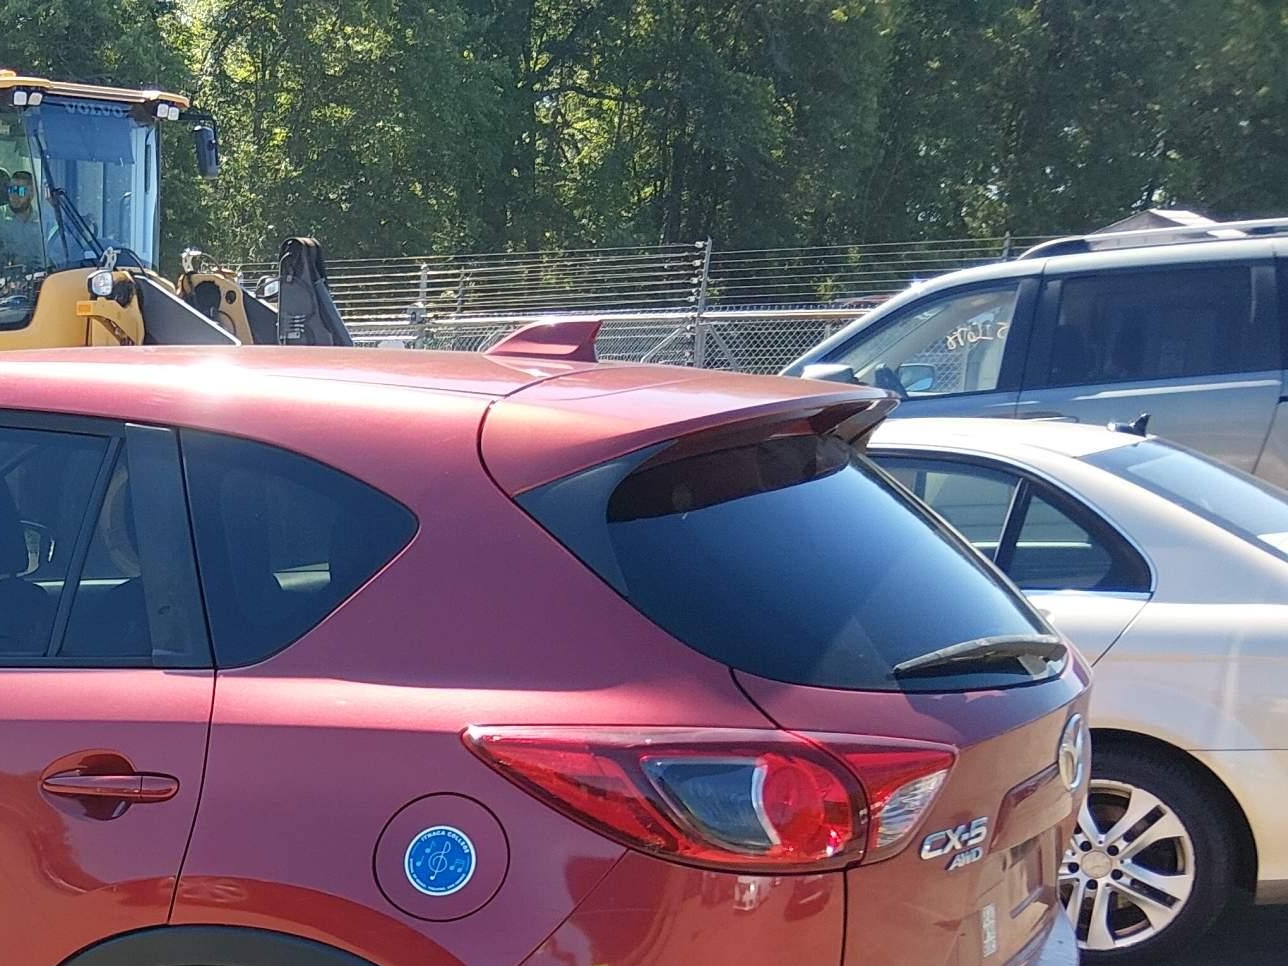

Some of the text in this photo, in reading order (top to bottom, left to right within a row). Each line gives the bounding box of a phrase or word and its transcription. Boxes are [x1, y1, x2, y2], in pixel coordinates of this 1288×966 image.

[65, 102, 124, 118] VOLVO
[919, 816, 989, 861] CX-5
[946, 846, 984, 871] AWD
